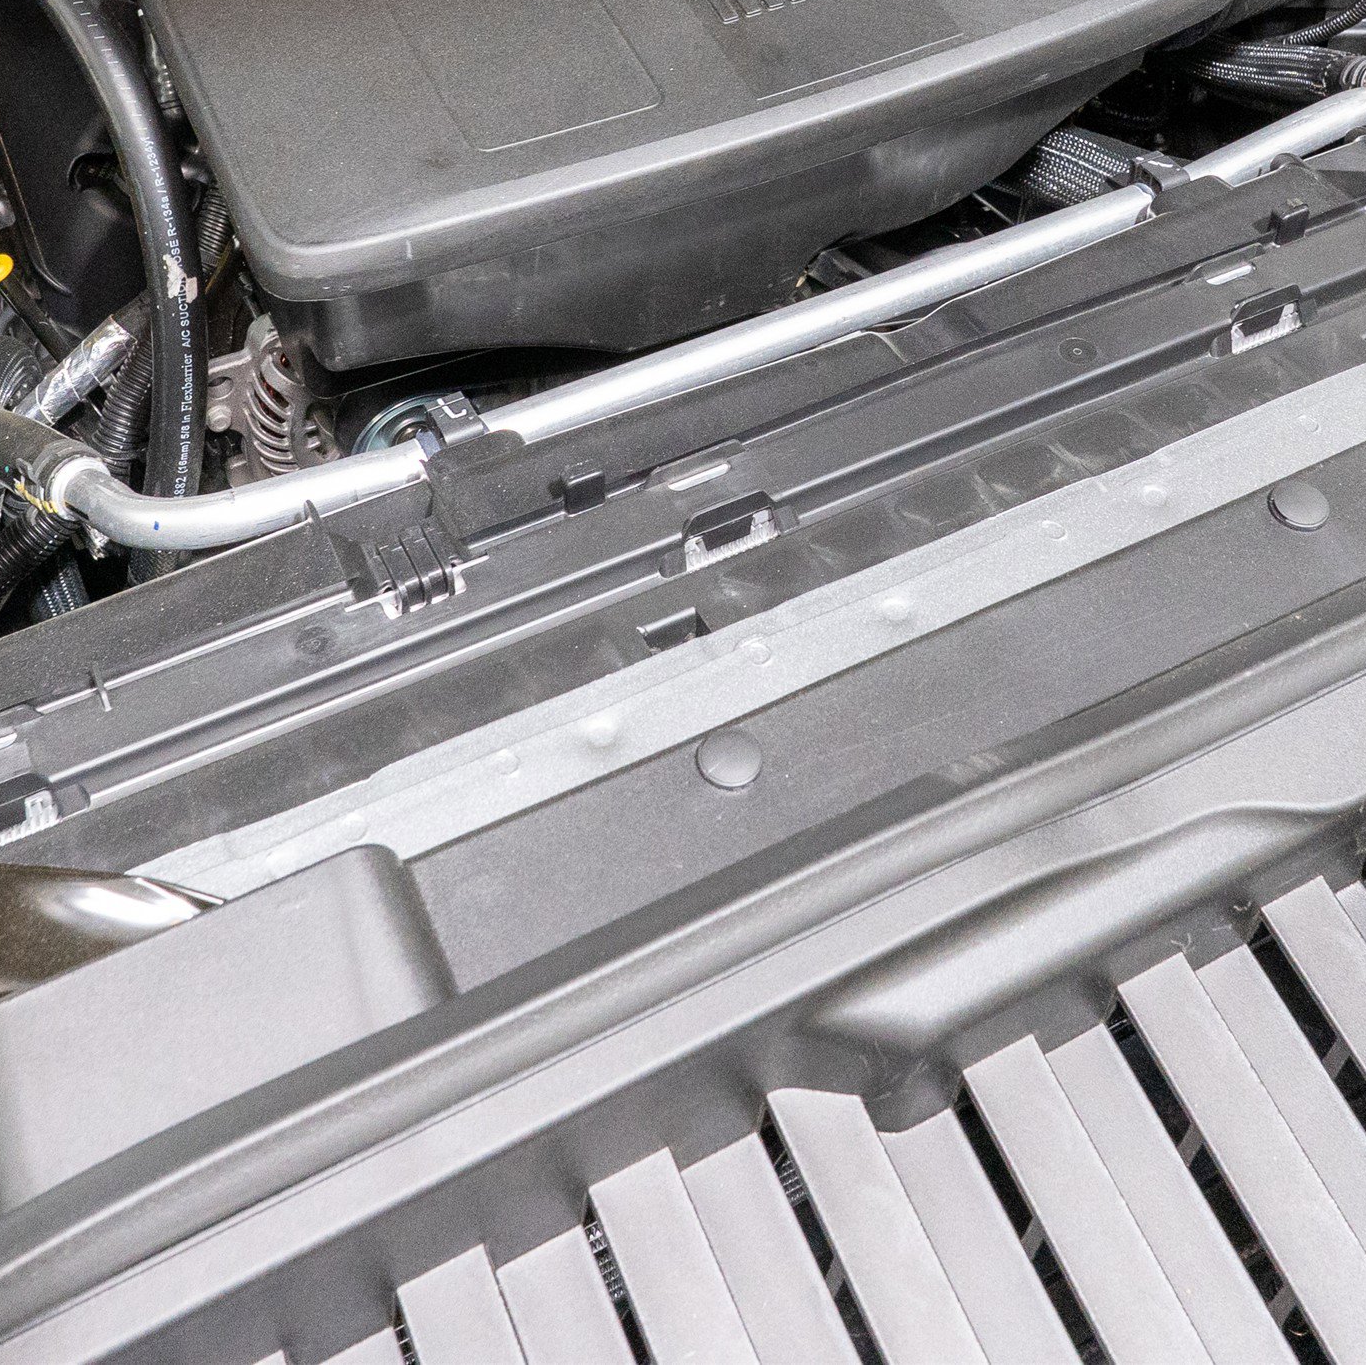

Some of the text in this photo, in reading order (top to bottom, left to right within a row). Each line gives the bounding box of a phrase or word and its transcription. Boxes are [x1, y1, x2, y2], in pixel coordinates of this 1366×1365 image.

[139, 136, 165, 187] R-1234yf
[161, 196, 177, 237] R-134a
[169, 238, 183, 268] OSE
[181, 329, 191, 348] A/C
[181, 353, 193, 412] Flexbarrier
[180, 424, 191, 439] 5/8
[177, 440, 191, 474] (16mm)
